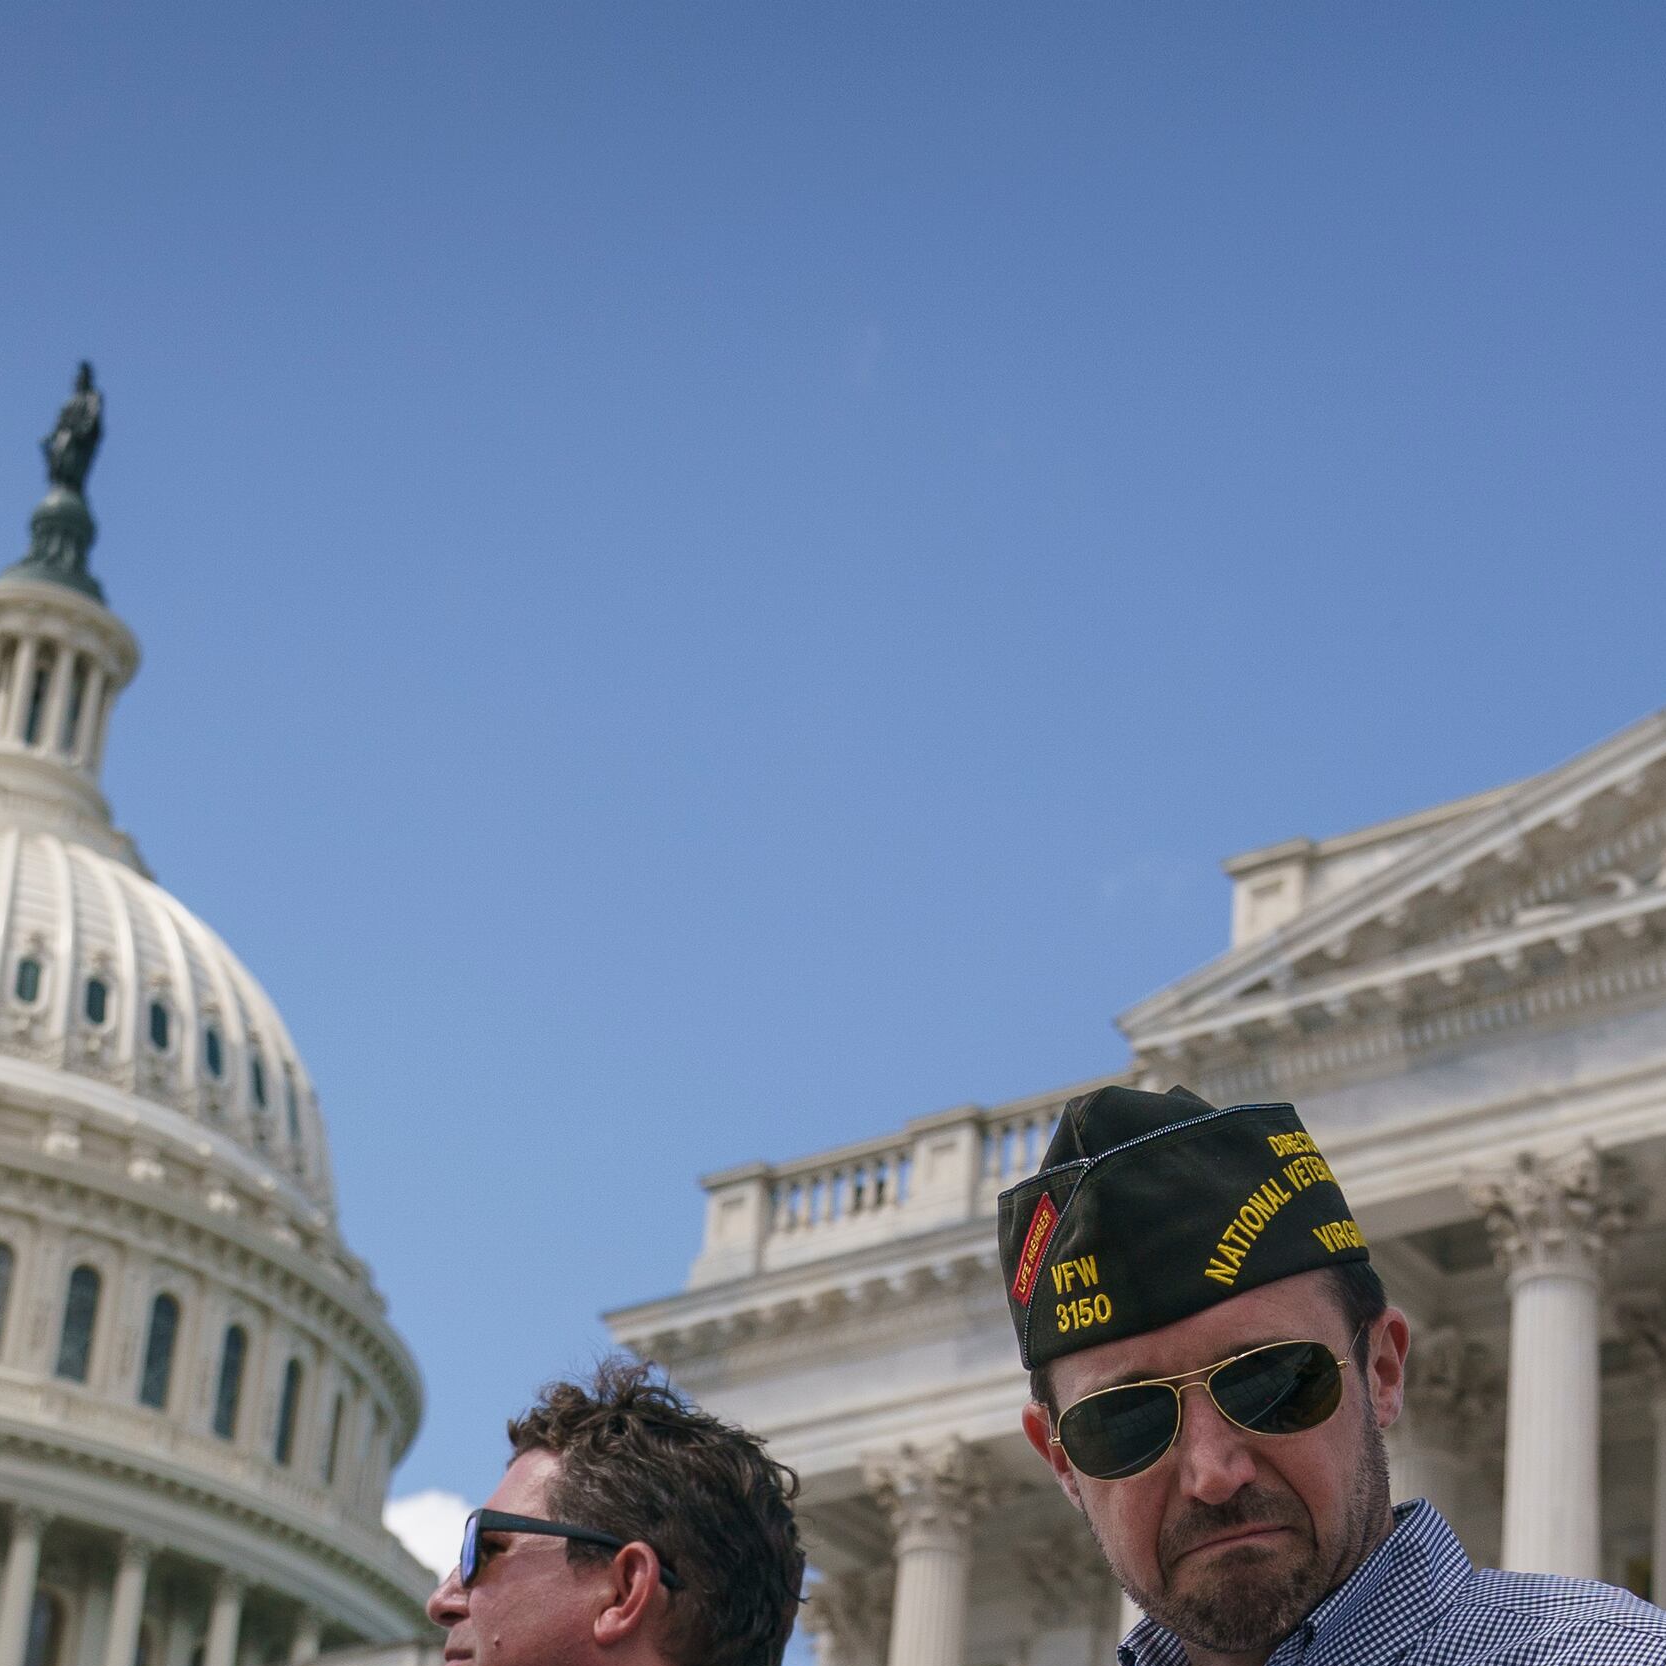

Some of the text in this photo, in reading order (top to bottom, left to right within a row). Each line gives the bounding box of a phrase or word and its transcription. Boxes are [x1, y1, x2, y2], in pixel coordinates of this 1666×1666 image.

[1017, 1209, 1052, 1293] LIFE MEMBER
[1204, 1178, 1293, 1286] NATIONAL
[1051, 1255, 1099, 1295] VFW
[1056, 1293, 1113, 1334] 3150
